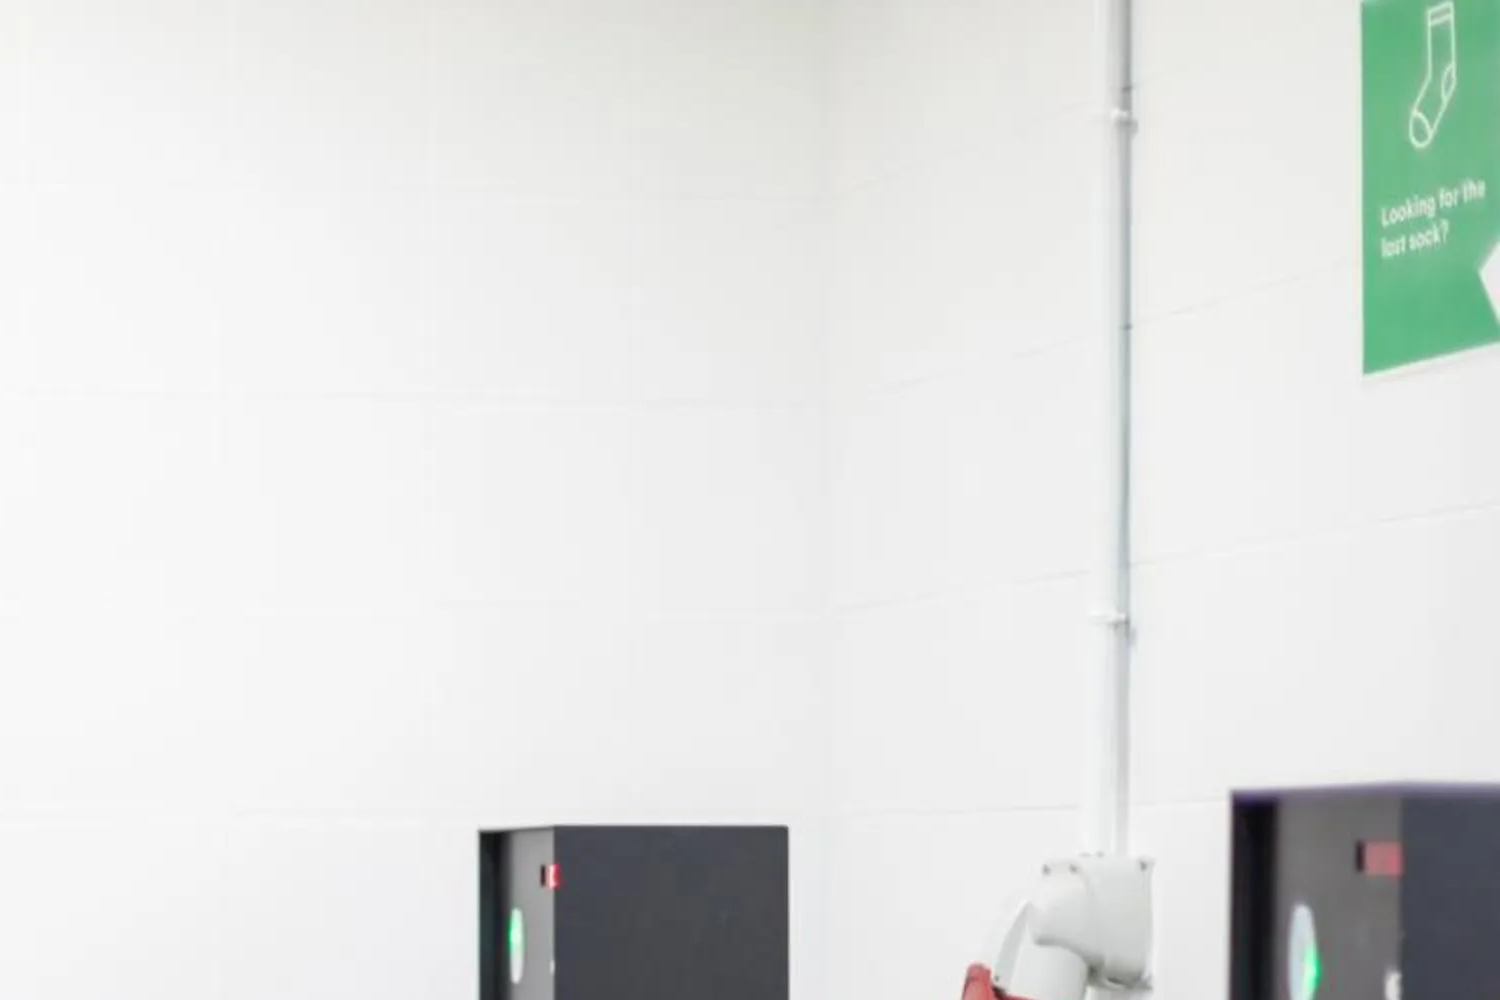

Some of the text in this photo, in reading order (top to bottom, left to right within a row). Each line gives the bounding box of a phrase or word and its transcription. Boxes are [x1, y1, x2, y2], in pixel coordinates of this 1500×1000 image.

[1381, 177, 1486, 229] Looking for the
[1409, 219, 1449, 251] sock?
